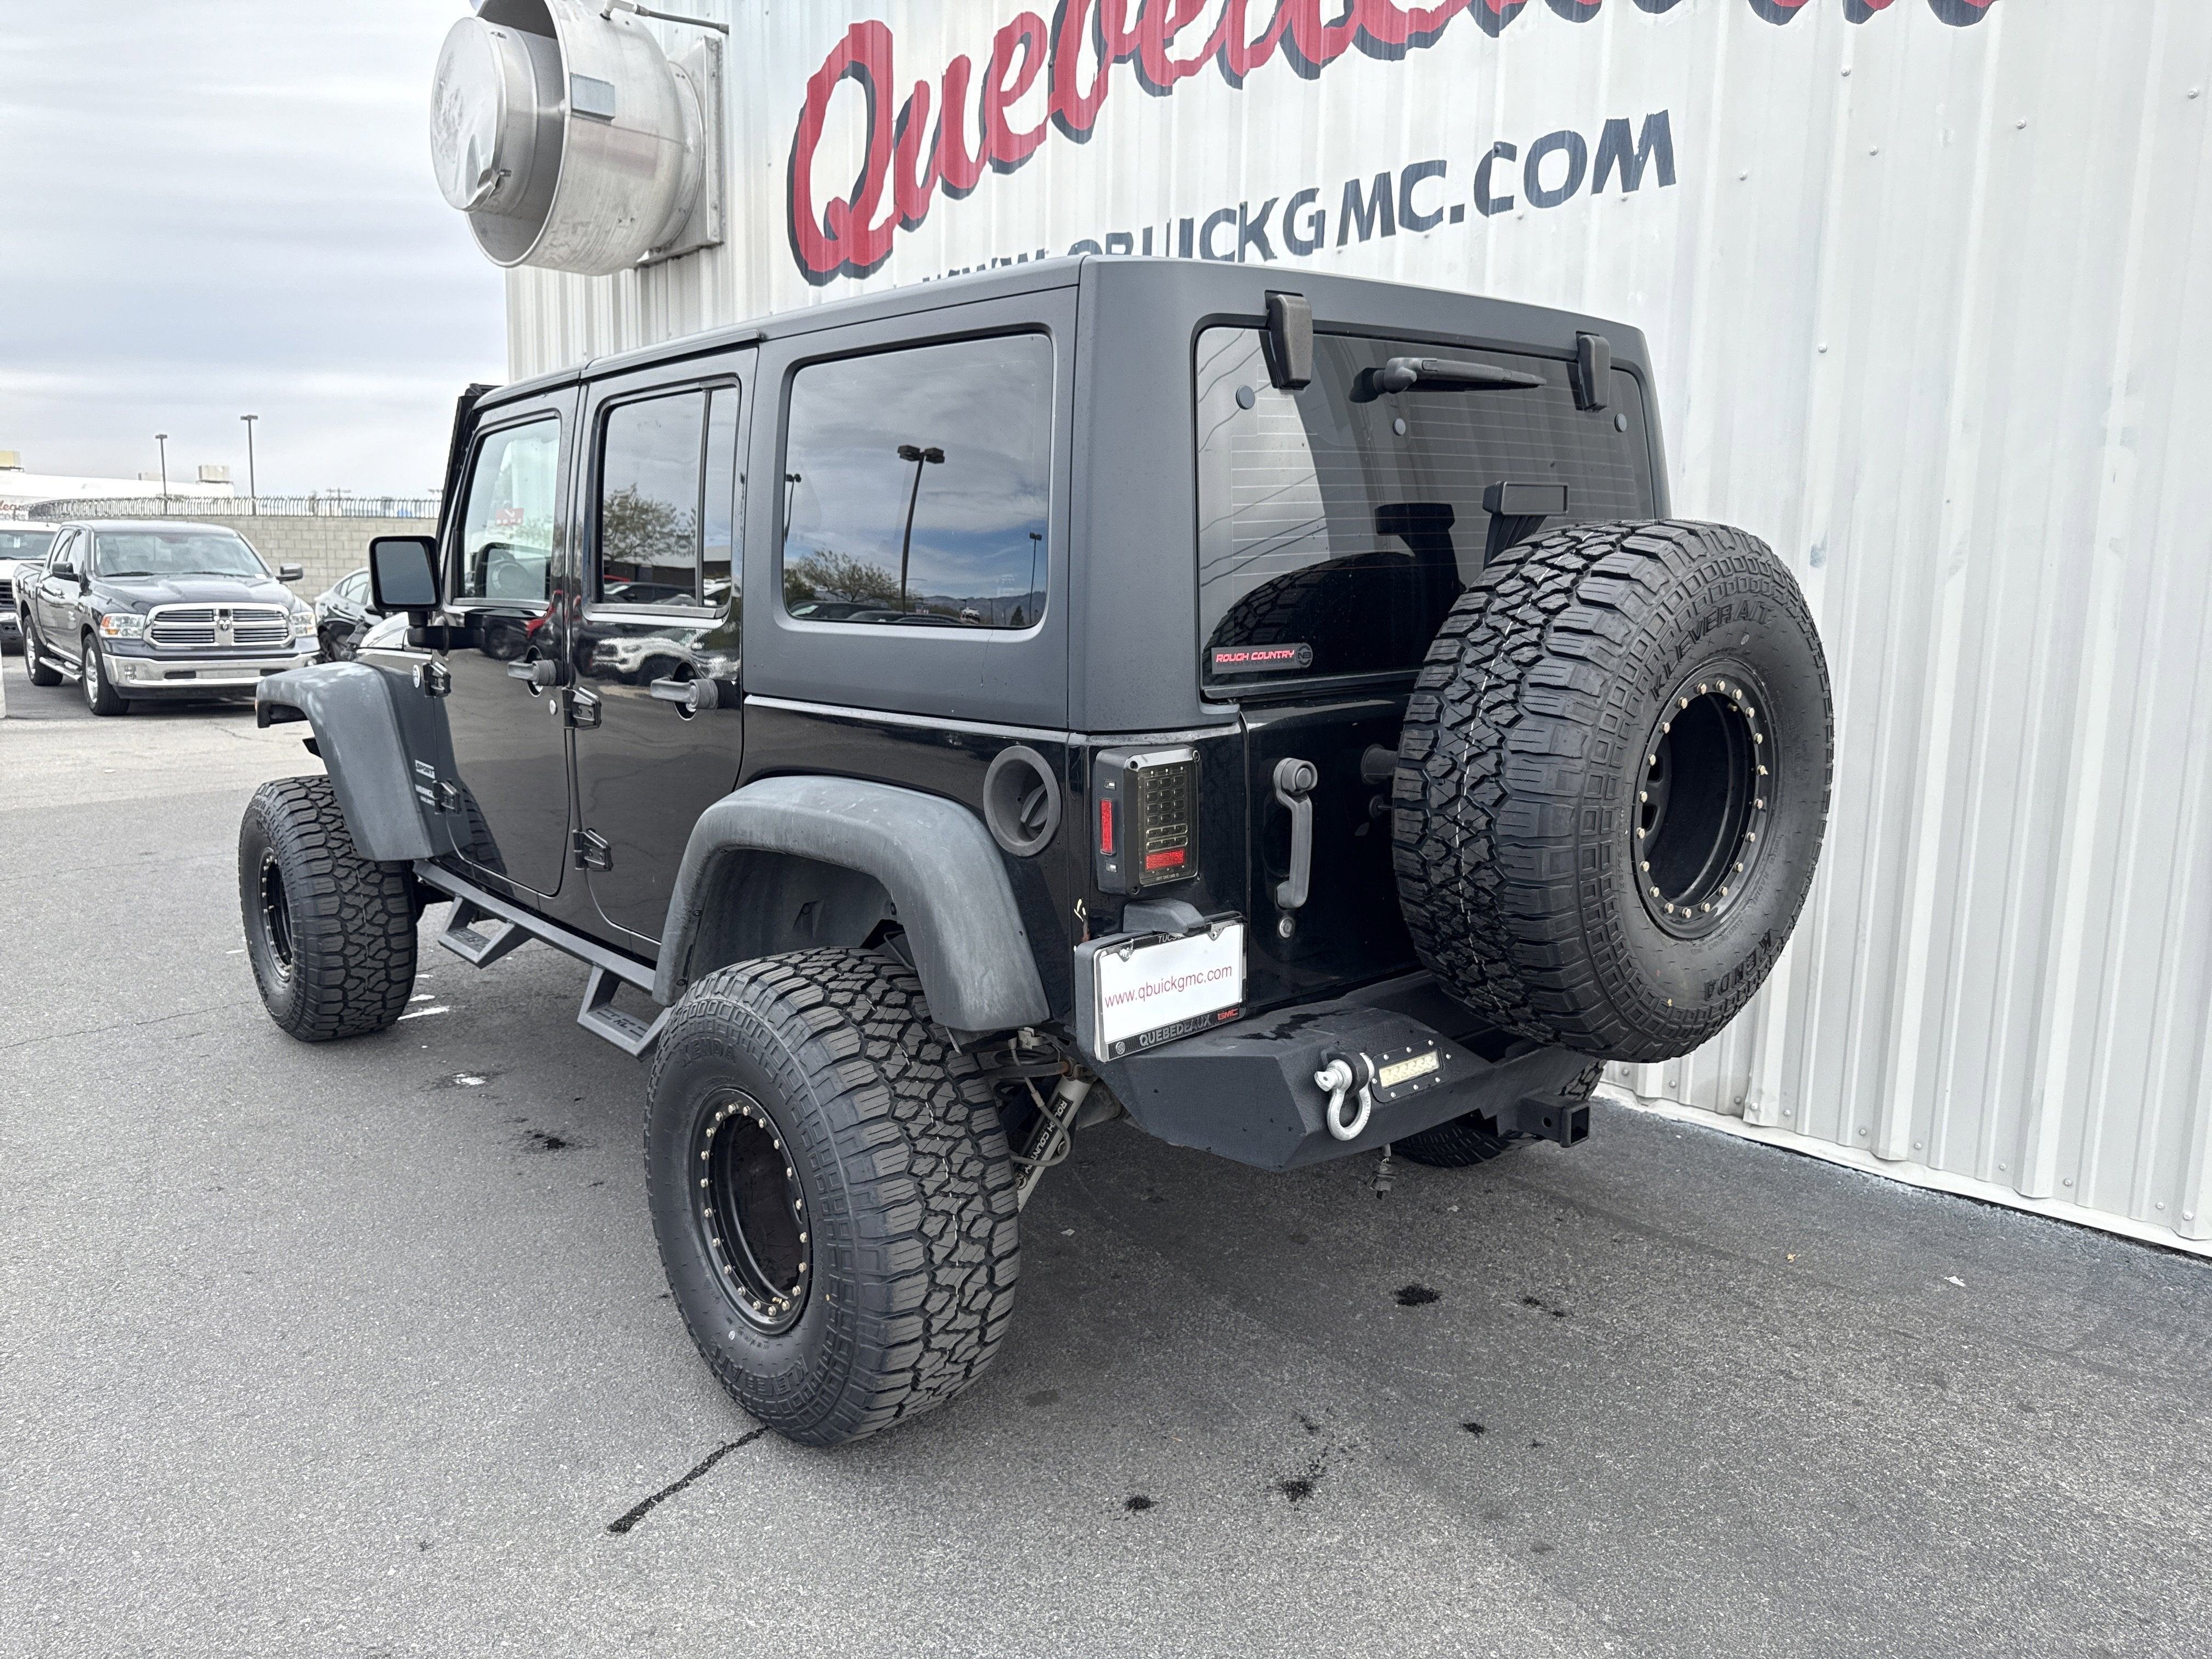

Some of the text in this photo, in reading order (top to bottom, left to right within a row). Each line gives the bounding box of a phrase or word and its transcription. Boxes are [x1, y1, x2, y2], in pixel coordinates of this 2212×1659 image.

[923, 109, 1676, 282] UICKGMC.COM
[1216, 652, 1249, 663] ROUGH
[1251, 650, 1295, 661] COUNTRY
[1651, 603, 1733, 701] KLEVER
[416, 762, 433, 775] SPORT
[1704, 927, 1771, 1001] KENDA
[1104, 965, 1232, 1008] www.qbuickgmc.com
[1139, 1008, 1238, 1047] QUEBEDEAUX GMC
[1047, 1100, 1068, 1132] ROUH
